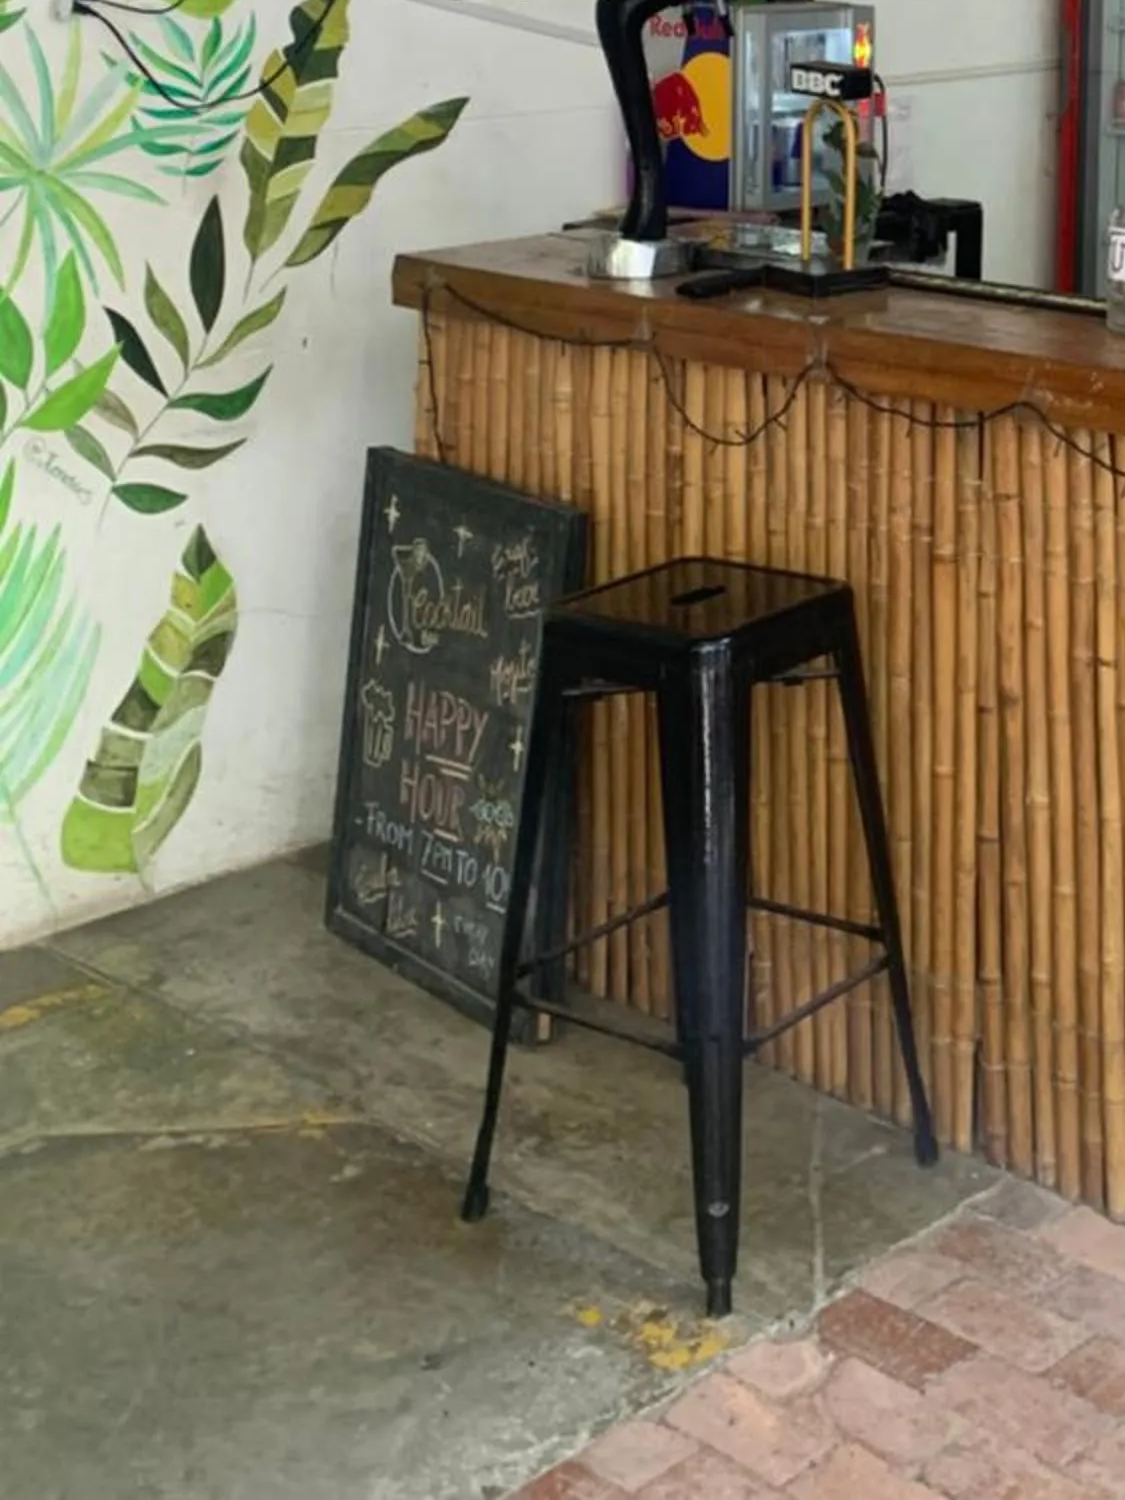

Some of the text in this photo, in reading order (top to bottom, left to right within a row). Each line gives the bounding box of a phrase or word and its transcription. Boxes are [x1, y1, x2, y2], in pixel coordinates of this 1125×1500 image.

[791, 68, 844, 97] BBC
[404, 680, 489, 762] HAPPY
[399, 759, 465, 838] HOUR
[456, 849, 478, 887] TO
